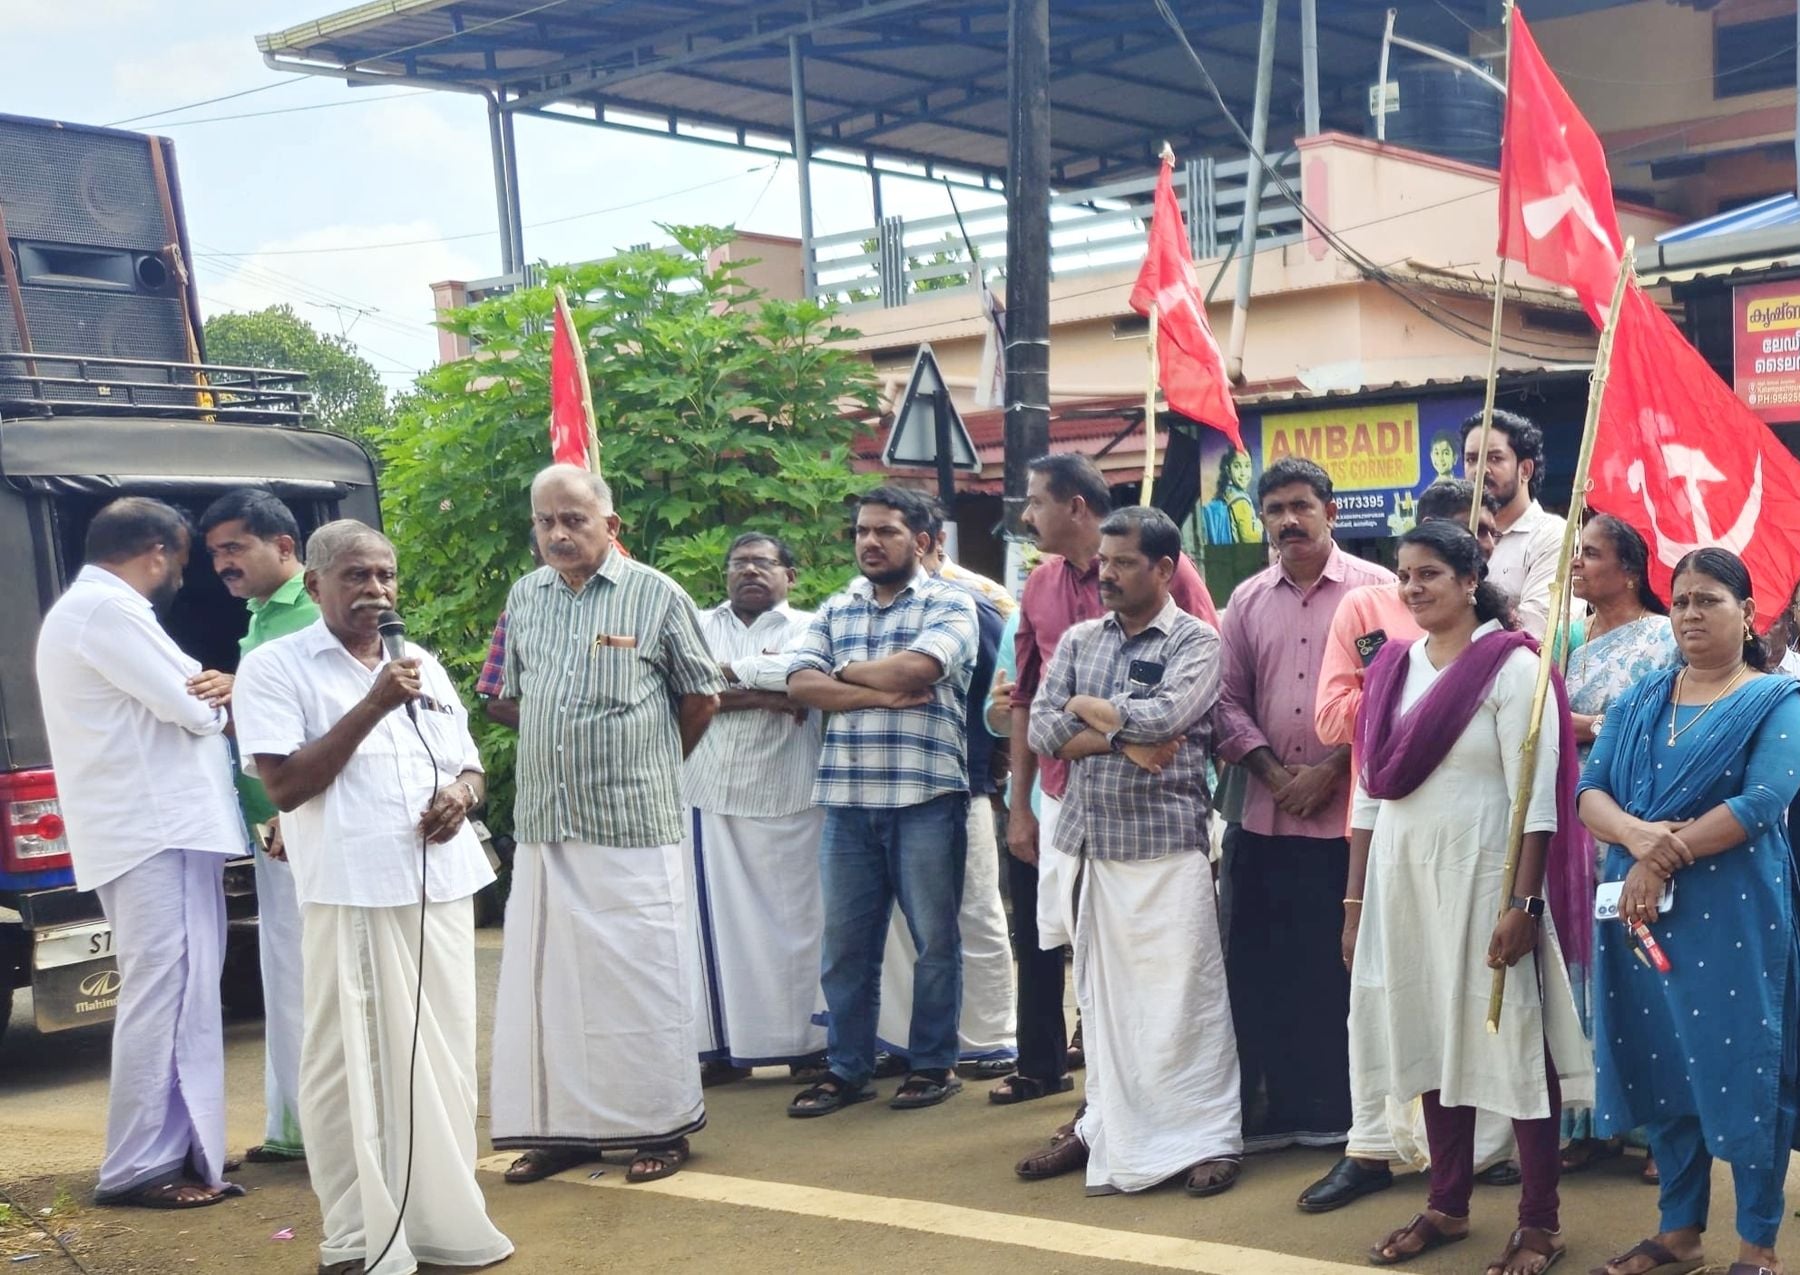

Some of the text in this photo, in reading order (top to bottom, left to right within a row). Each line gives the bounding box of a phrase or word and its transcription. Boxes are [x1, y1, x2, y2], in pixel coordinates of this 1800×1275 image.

[1270, 420, 1413, 462] AMBADI
[1350, 457, 1403, 480] CORNER
[1335, 494, 1384, 510] 8173395
